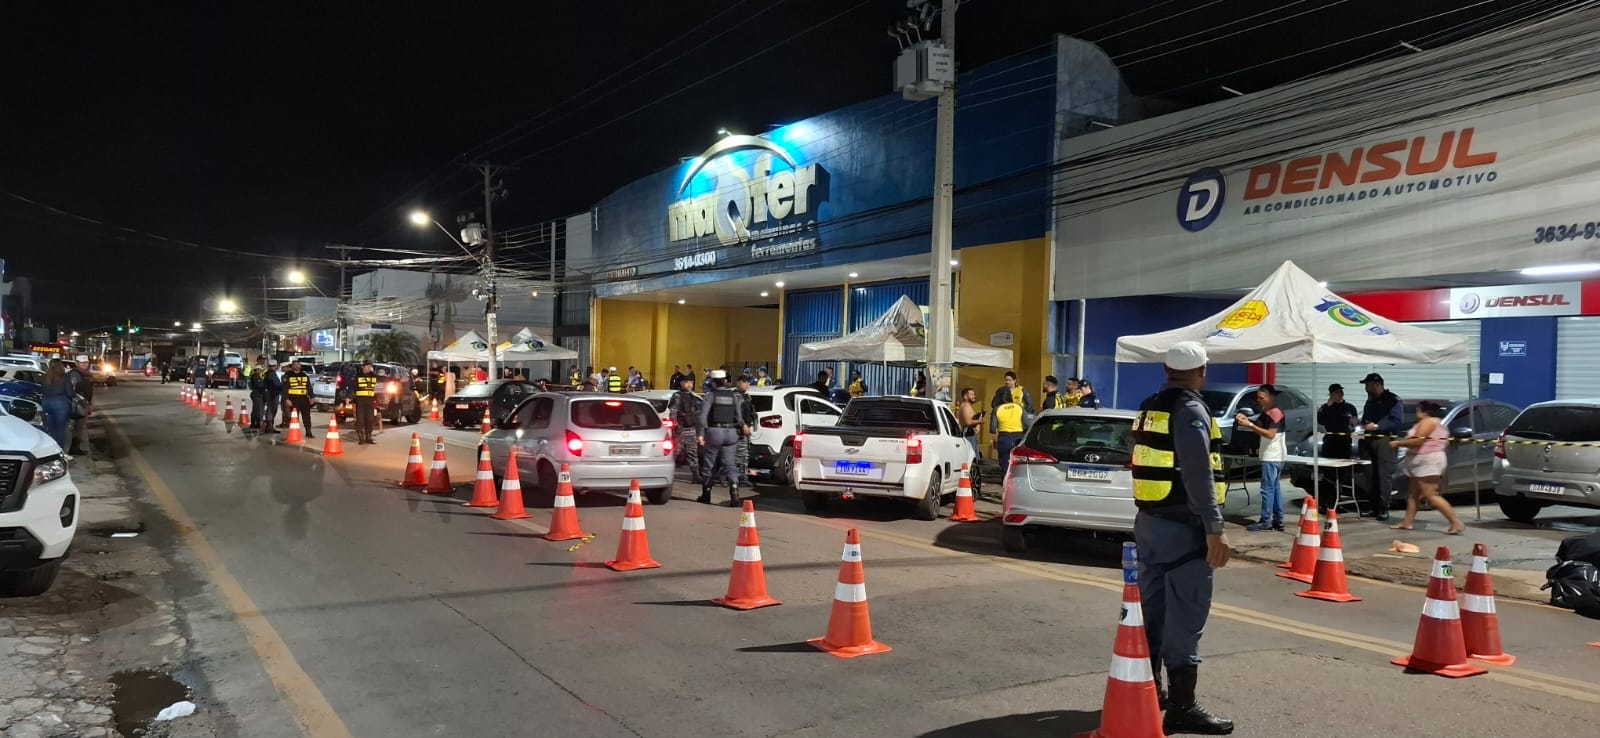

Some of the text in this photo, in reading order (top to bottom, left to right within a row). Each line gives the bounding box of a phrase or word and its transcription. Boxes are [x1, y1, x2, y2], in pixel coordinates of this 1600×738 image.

[1242, 127, 1498, 201] DENSUL
[1186, 179, 1220, 222] D
[1243, 171, 1498, 215] AR CONDICIONADO AUTOMOTIVO
[1484, 293, 1571, 309] DENSUL
